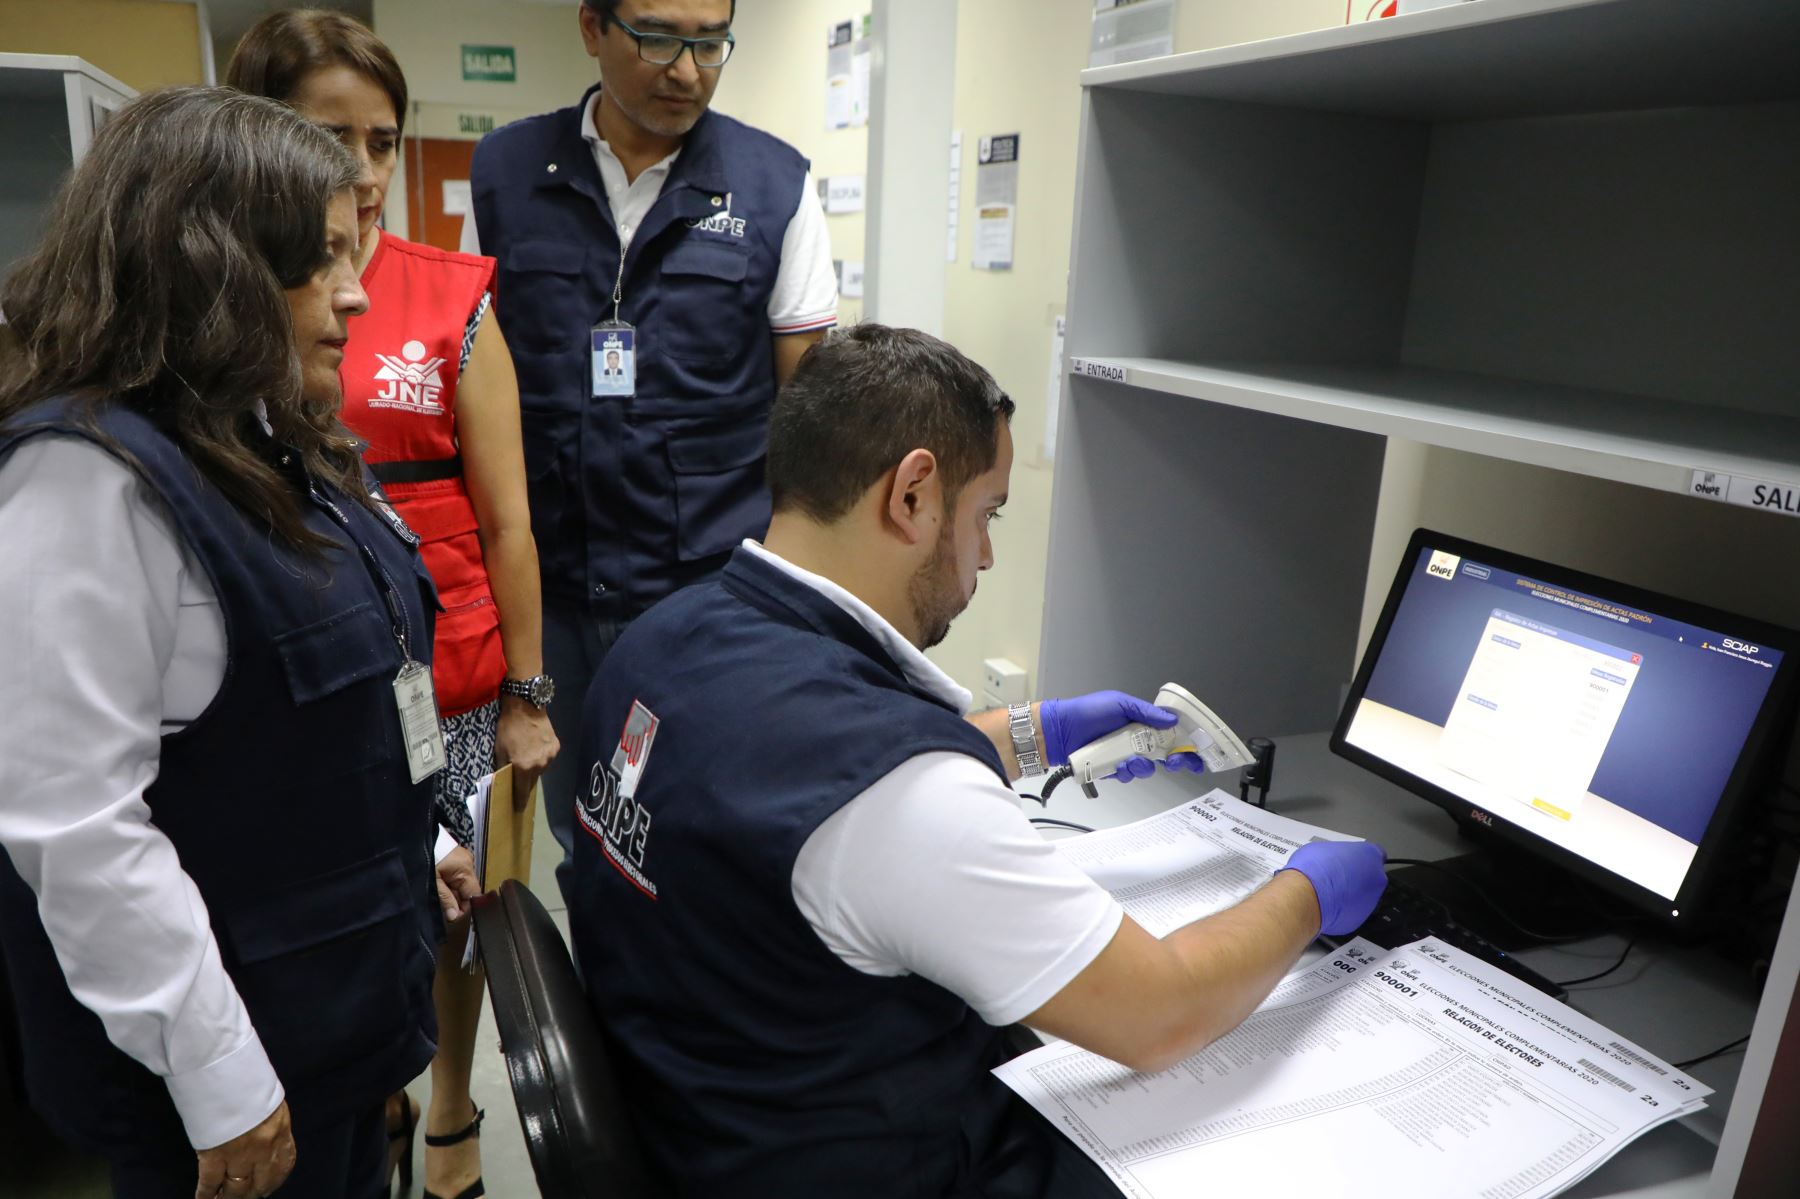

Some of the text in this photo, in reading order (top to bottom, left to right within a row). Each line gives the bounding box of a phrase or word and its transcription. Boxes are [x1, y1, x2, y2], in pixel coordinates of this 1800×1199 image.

[464, 53, 512, 73] SALIDA
[458, 113, 494, 133] SALIDA
[684, 215, 746, 237] NPE
[1087, 363, 1124, 381] ENTRADA
[377, 381, 440, 406] JNE
[1695, 484, 1720, 496] ONPE
[1430, 564, 1452, 577] ONPE
[586, 760, 651, 868] ONPE
[1189, 805, 1218, 822] 900002
[1471, 809, 1492, 827] DELL
[1232, 827, 1255, 841] RELACION
[1260, 840, 1289, 855] ELECTORES
[1429, 953, 1448, 963] ONPE
[1374, 971, 1418, 997] 900001
[1400, 970, 1419, 981] ONPE
[1449, 965, 1489, 987] ELECCIONES
[1488, 985, 1535, 1013] MUNICIPALES
[1536, 1011, 1609, 1054] COMPLEMENTARIAS
[1610, 1053, 1632, 1066] 2020
[1419, 982, 1459, 1006] ELECCIONES
[1458, 1003, 1505, 1032] MUNICIPALES
[1504, 1030, 1578, 1074] COMPLEMENTARIAS
[1577, 1070, 1599, 1085] 2020
[1443, 1008, 1545, 1068] RELACION DE ELECTORES
[1640, 1094, 1659, 1107] 2a
